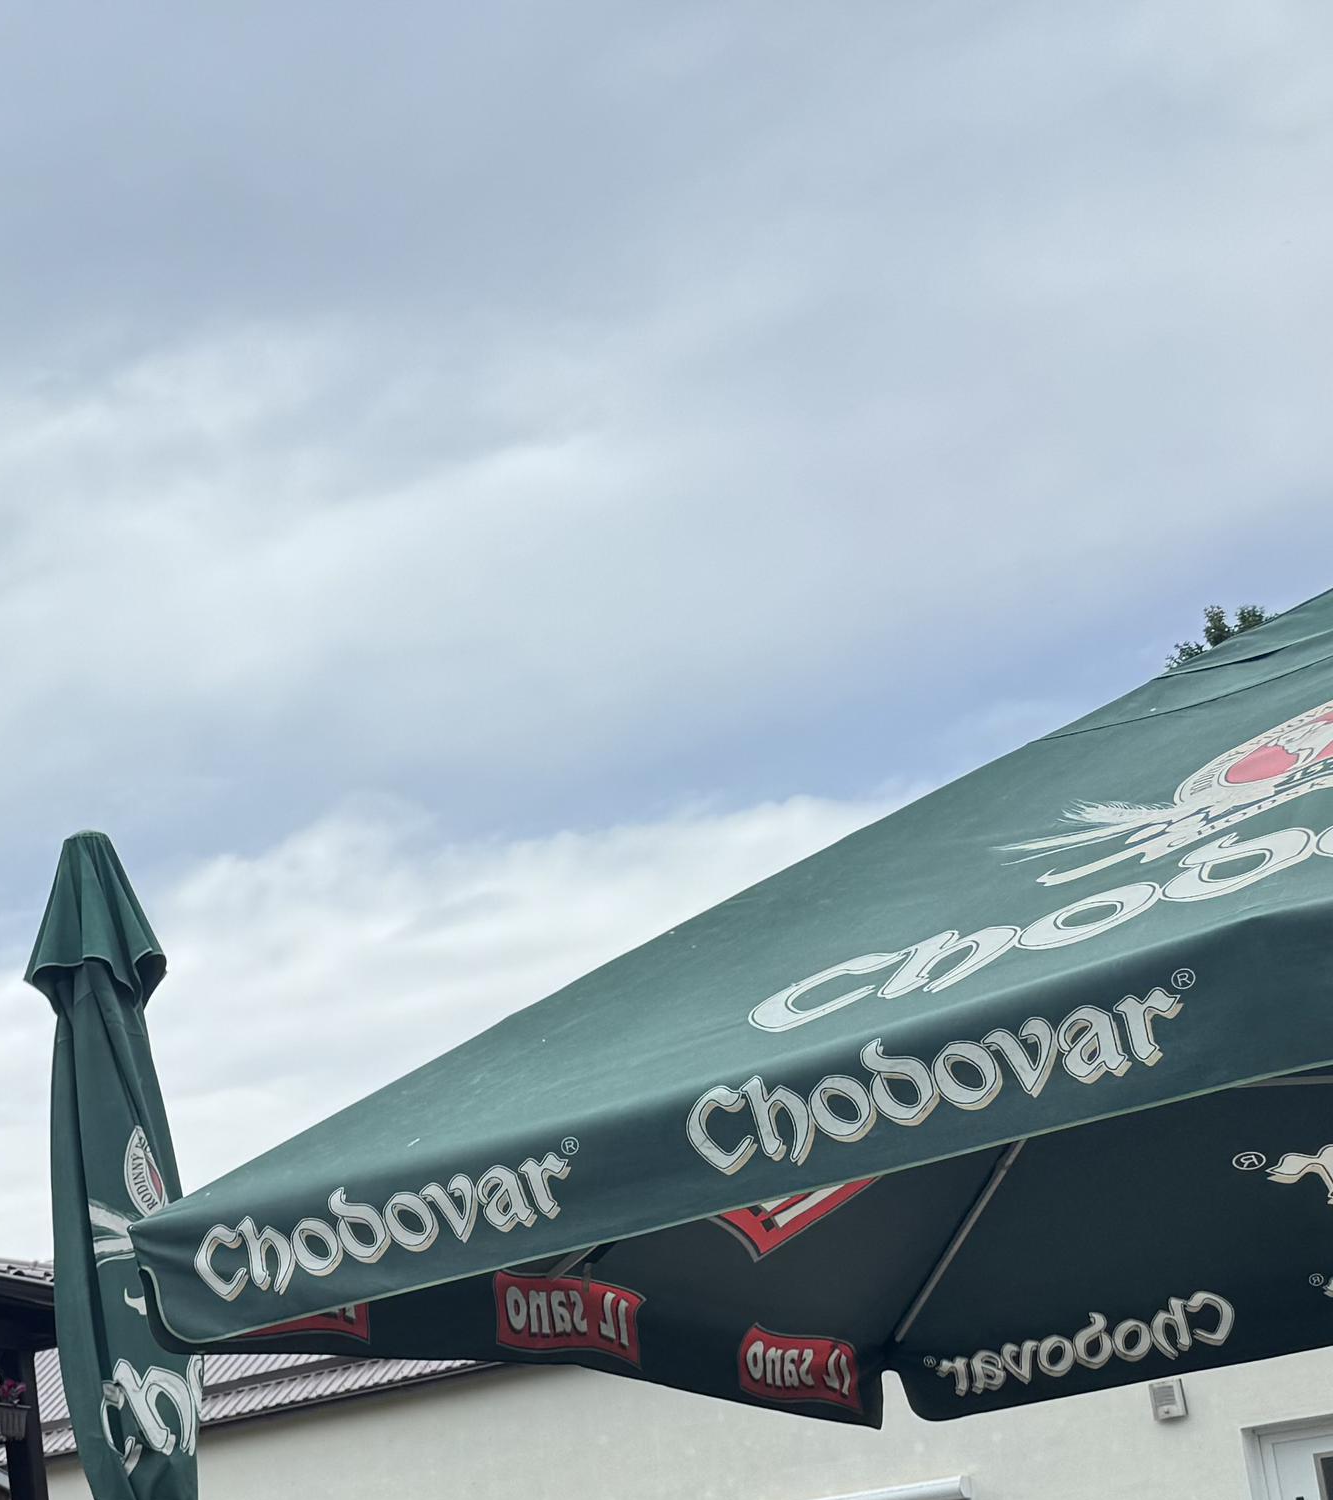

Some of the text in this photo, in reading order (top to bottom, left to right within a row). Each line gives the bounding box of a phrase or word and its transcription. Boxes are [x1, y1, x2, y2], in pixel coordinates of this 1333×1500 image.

[748, 826, 1333, 1033] Chod
[686, 986, 1183, 1176] Chodovar
[131, 1154, 158, 1211] RODINNÝ
[194, 1152, 571, 1302] Chodovar
